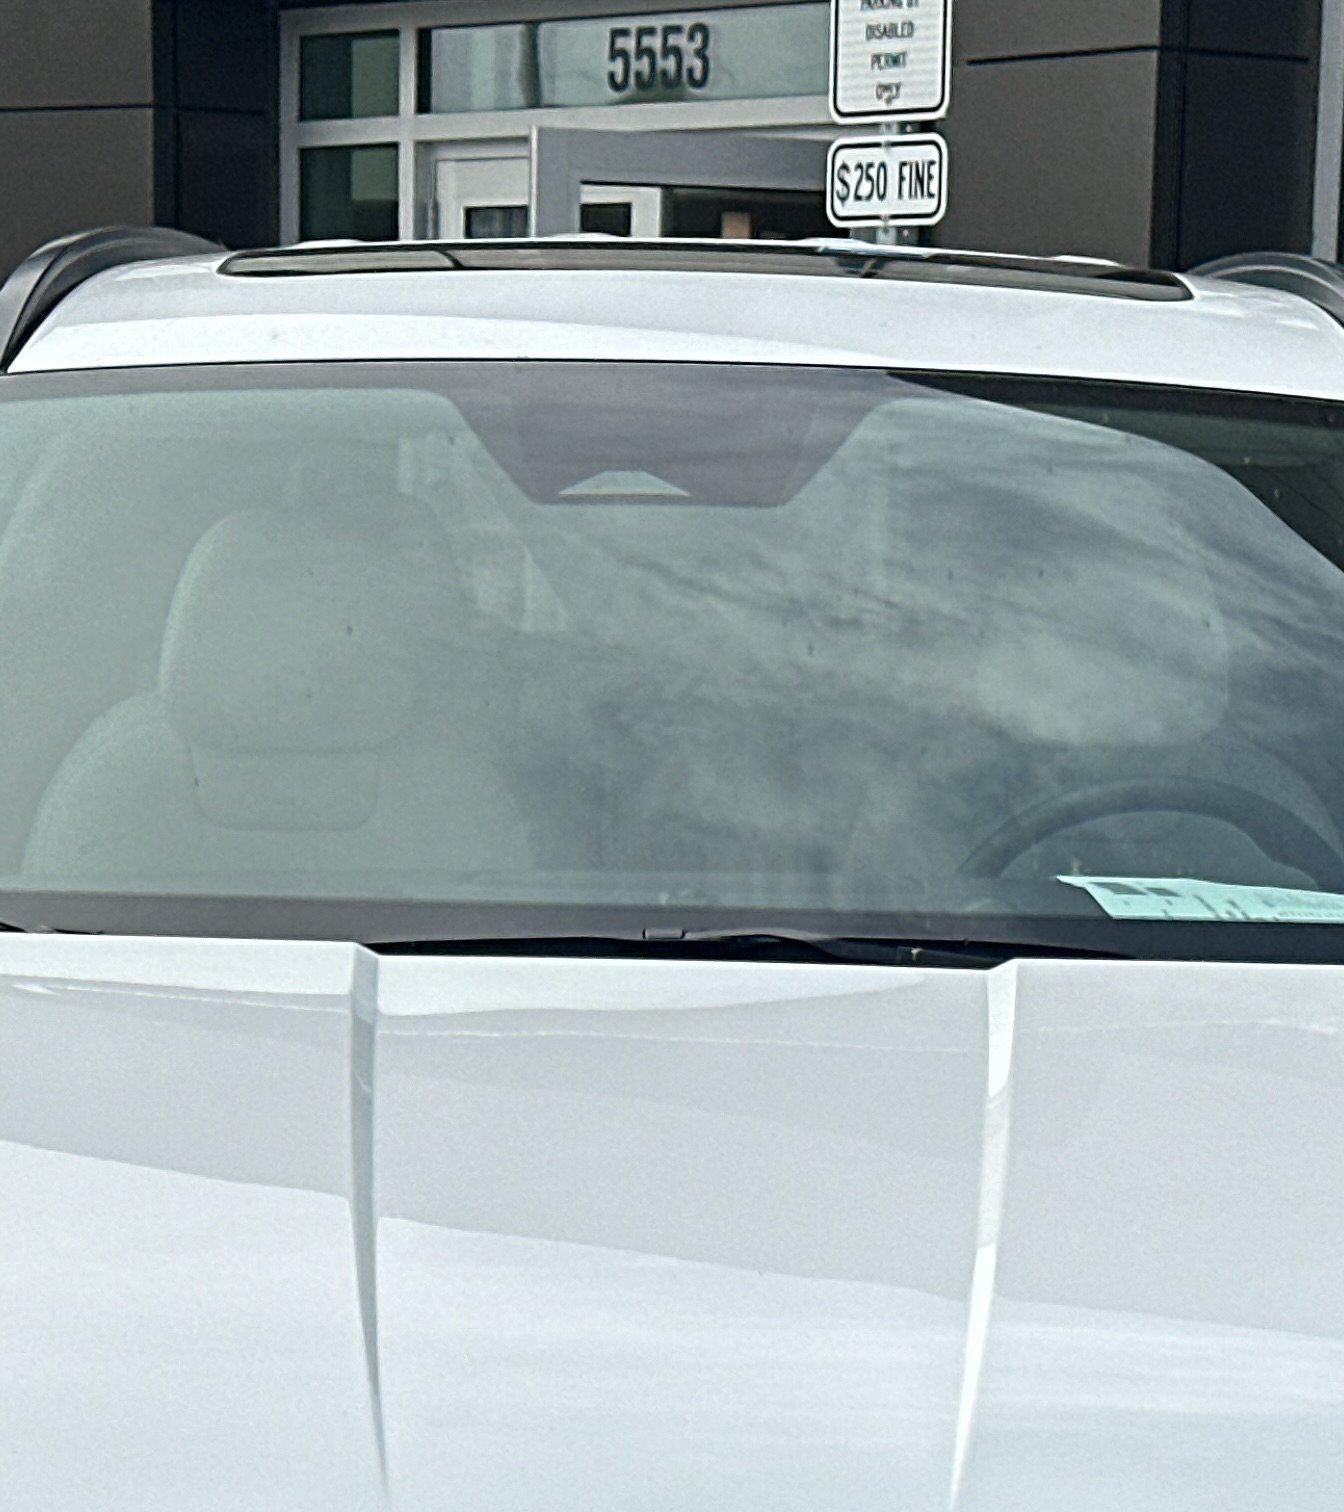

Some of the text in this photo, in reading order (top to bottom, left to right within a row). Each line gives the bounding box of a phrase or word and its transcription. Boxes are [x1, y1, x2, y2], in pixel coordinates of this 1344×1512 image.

[607, 22, 710, 92] 5553
[835, 159, 937, 207] $250 FINE
